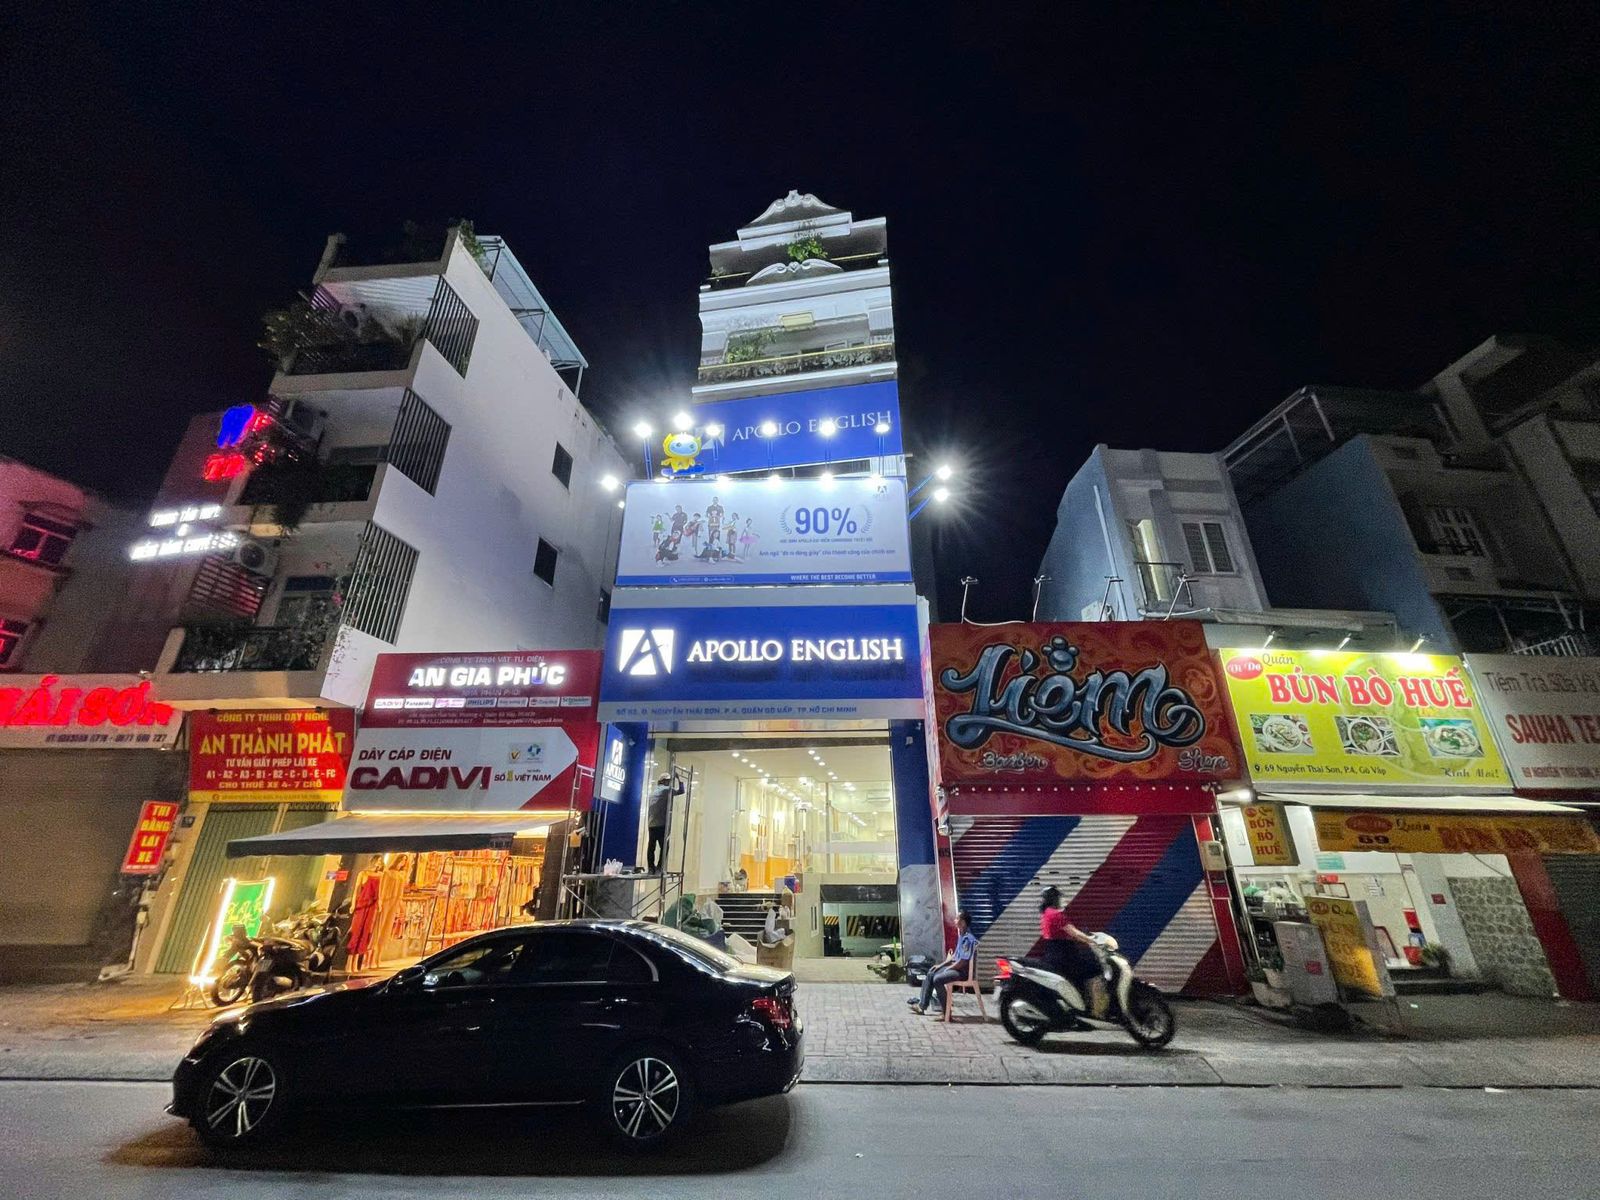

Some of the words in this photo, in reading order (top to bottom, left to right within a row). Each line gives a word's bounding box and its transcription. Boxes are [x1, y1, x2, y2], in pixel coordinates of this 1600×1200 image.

[732, 421, 801, 441] APOLO
[794, 506, 857, 536] 90%
[686, 639, 783, 662] APOLLO
[791, 638, 903, 661] ENGLISH
[1262, 653, 1294, 666] Quán
[408, 667, 446, 686] AN
[450, 667, 492, 686] GIA
[496, 662, 566, 686] PHÚC
[1266, 666, 1342, 704] BÚN
[1344, 668, 1394, 706] BÒ
[1397, 667, 1473, 708] HUẾ
[246, 712, 256, 722] TY
[258, 712, 281, 722] TNHH
[199, 733, 226, 755] AN
[230, 727, 293, 754] THÀNH
[297, 726, 345, 754] PHÁT
[358, 747, 385, 760] DÂY
[388, 747, 415, 760] CÁP
[420, 747, 451, 761] ĐIỆN
[307, 757, 317, 767] XE
[206, 770, 216, 779] A1
[223, 770, 233, 779] A2
[289, 770, 296, 779] C
[314, 769, 320, 778] E
[1265, 765, 1275, 773] 69
[1276, 764, 1305, 776] Nguyễn
[350, 767, 492, 790] CADIVI
[494, 772, 506, 781] SỐ
[514, 773, 531, 782] VIỆT
[219, 781, 238, 789] CHO
[152, 805, 171, 817] THI
[1248, 816, 1275, 829] BÚN
[1256, 829, 1274, 841] BÒ
